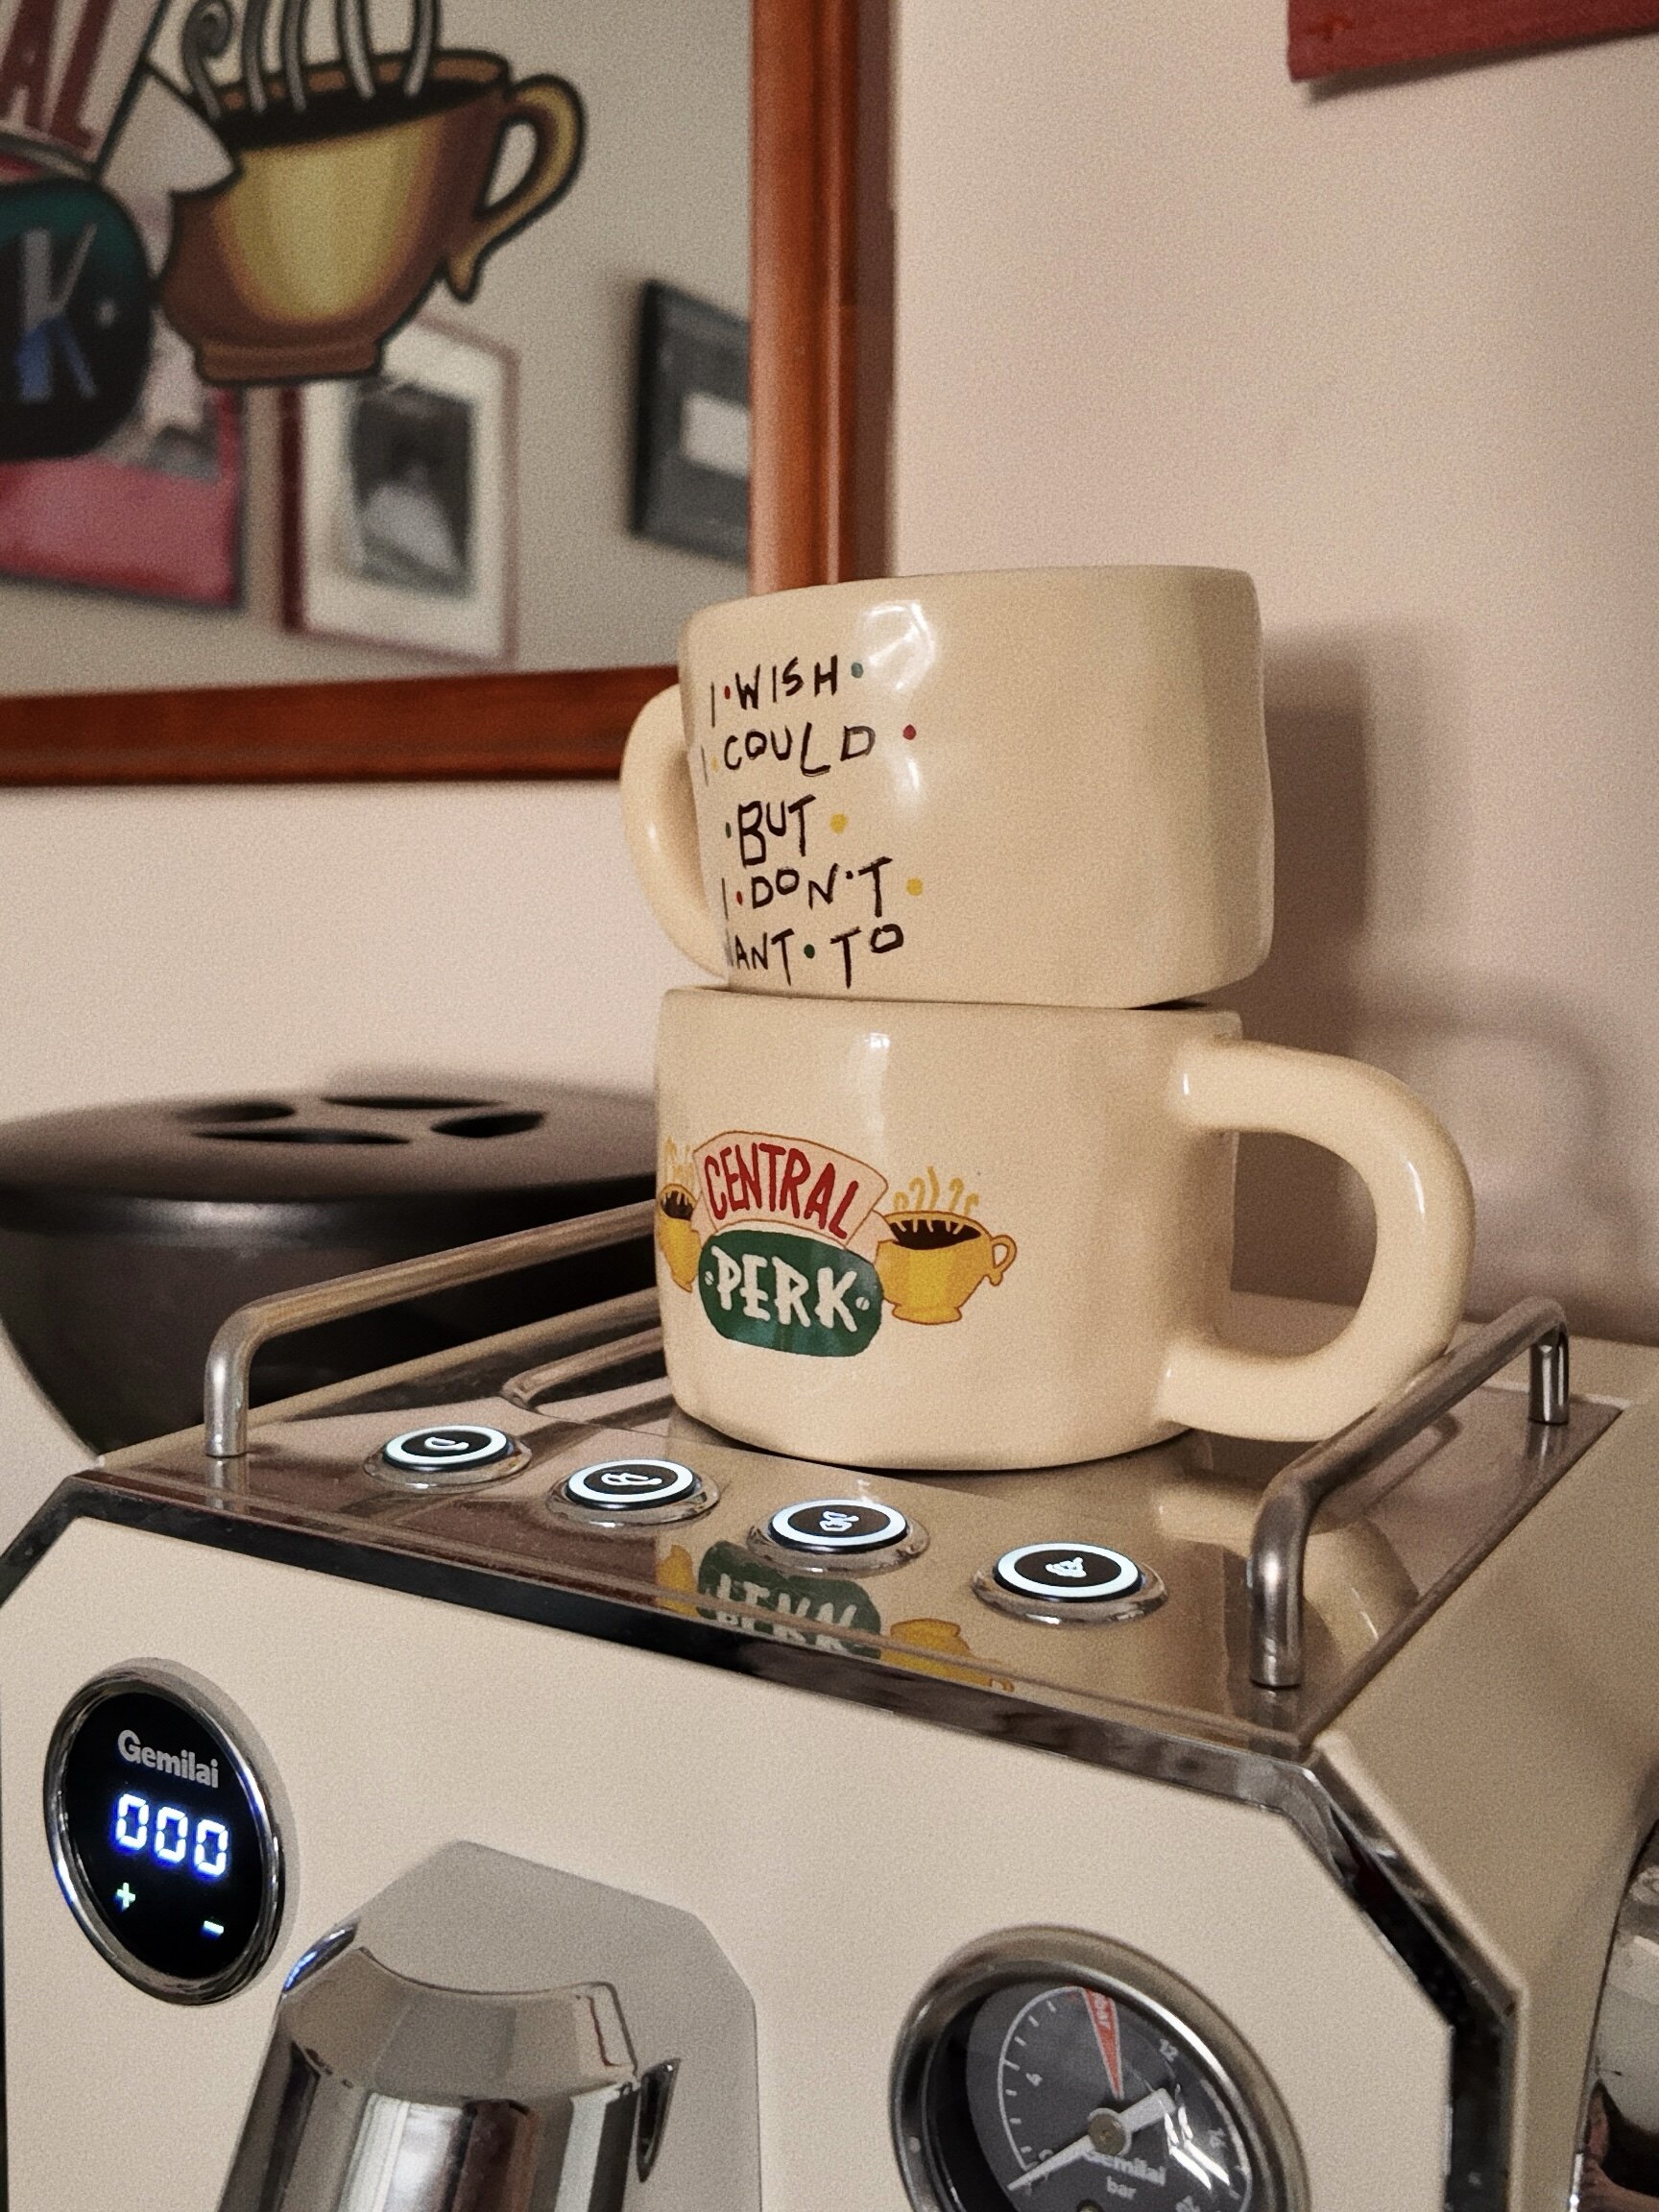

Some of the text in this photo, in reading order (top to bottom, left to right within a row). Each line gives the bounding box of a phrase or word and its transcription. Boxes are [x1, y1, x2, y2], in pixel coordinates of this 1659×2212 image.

[735, 655, 838, 709] WISH
[724, 722, 876, 777] COULD
[737, 795, 816, 869] BUT
[752, 856, 893, 918] DON'T
[830, 924, 904, 989] TO
[704, 1142, 859, 1239] CENTRAL
[711, 1245, 858, 1333] PERK
[117, 1729, 219, 1789] Gemilai
[115, 1793, 228, 1877] 000
[1106, 2175, 1137, 2200] bar
